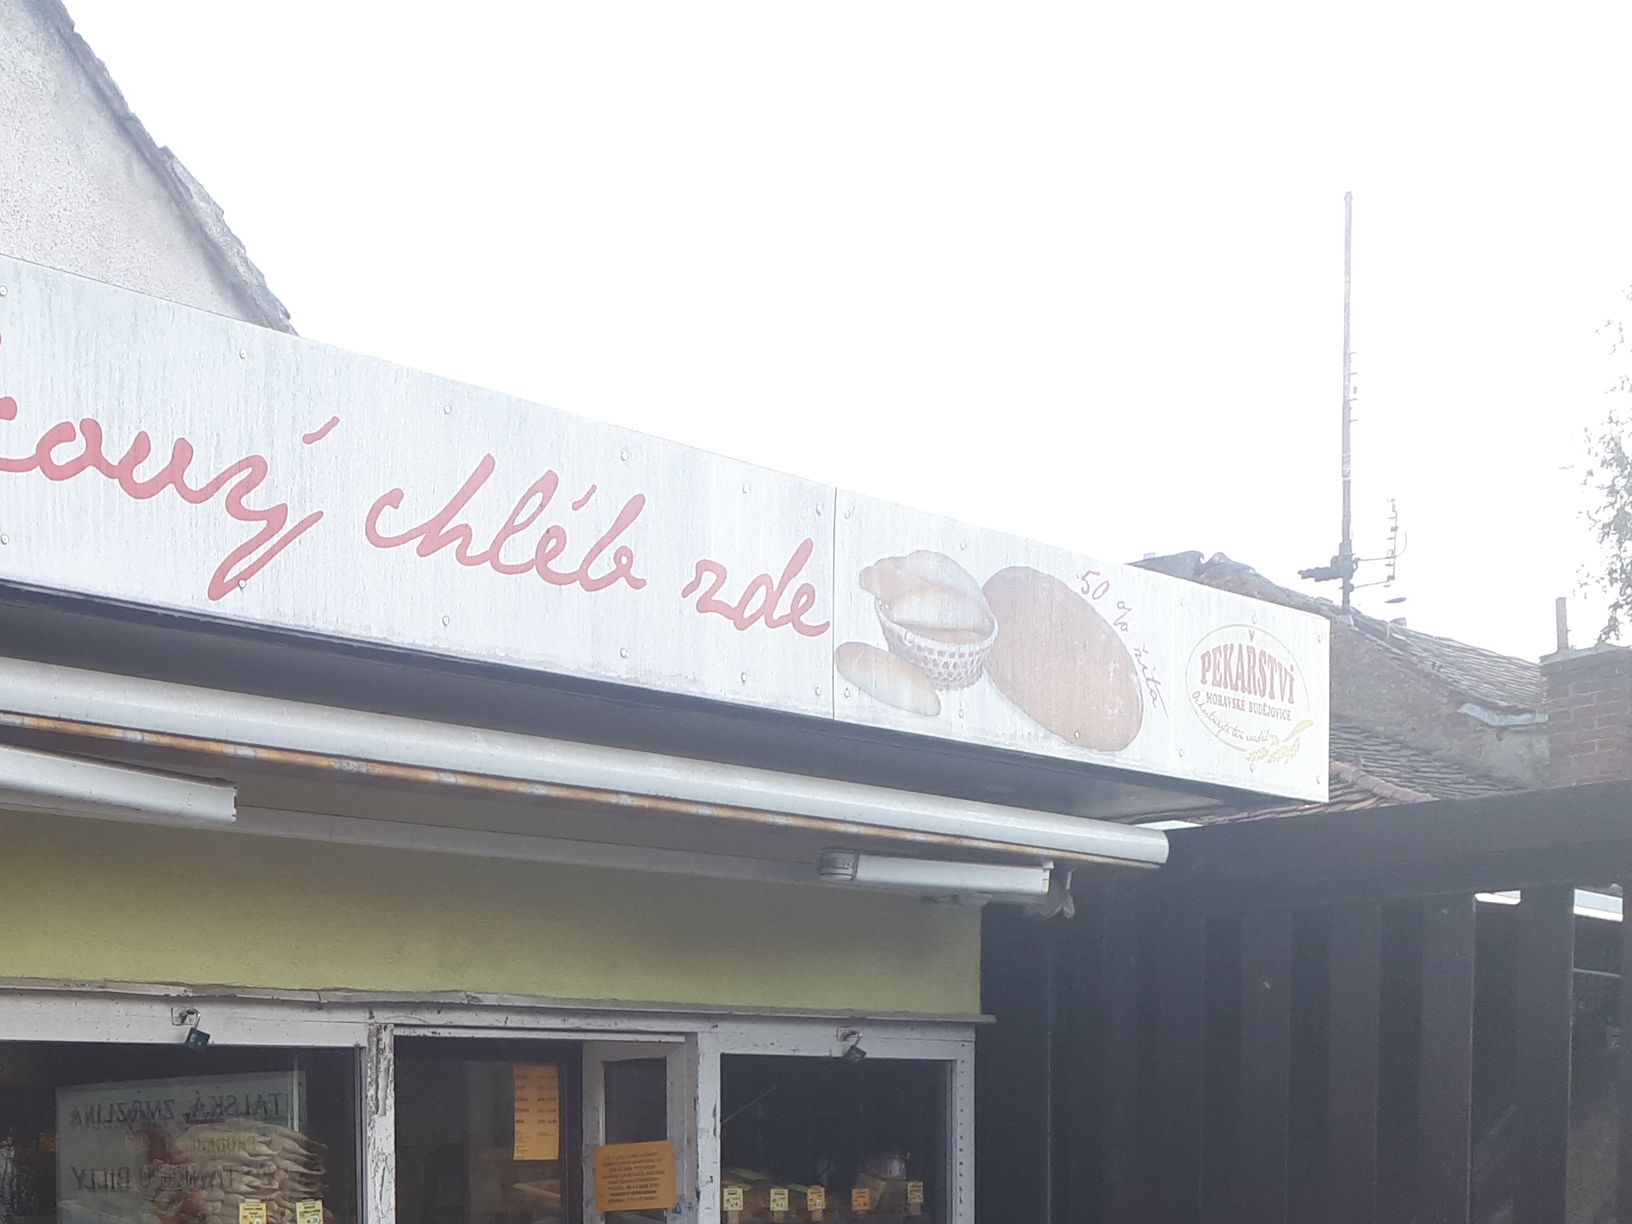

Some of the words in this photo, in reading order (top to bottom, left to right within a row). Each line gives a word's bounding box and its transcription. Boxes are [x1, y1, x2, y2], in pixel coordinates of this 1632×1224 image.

[365, 454, 647, 591] chléb
[682, 538, 830, 637] zde
[1079, 570, 1110, 600] 50
[1200, 629, 1295, 704] PEKAŘSTVÍ
[1206, 691, 1246, 711] MORAVSKÉ
[1248, 702, 1291, 721] BUDĚJOVICE
